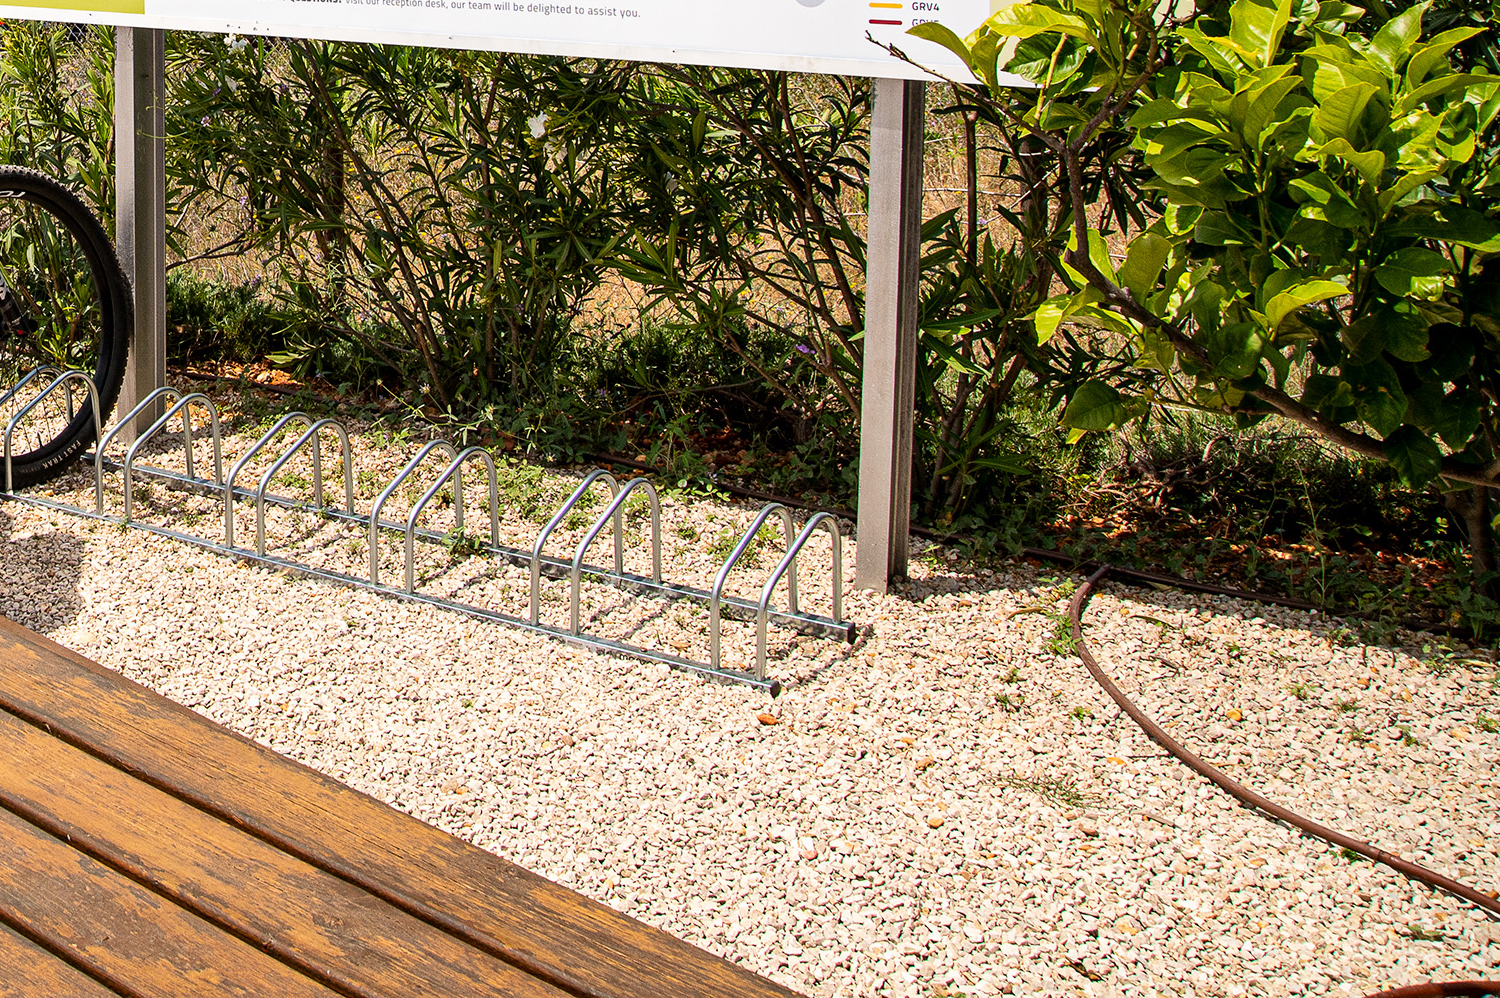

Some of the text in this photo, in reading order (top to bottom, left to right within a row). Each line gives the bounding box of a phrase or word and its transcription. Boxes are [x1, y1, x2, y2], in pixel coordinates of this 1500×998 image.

[912, 2, 939, 11] GRV4
[63, 439, 82, 458] FAST
[42, 454, 64, 470] TRAK
